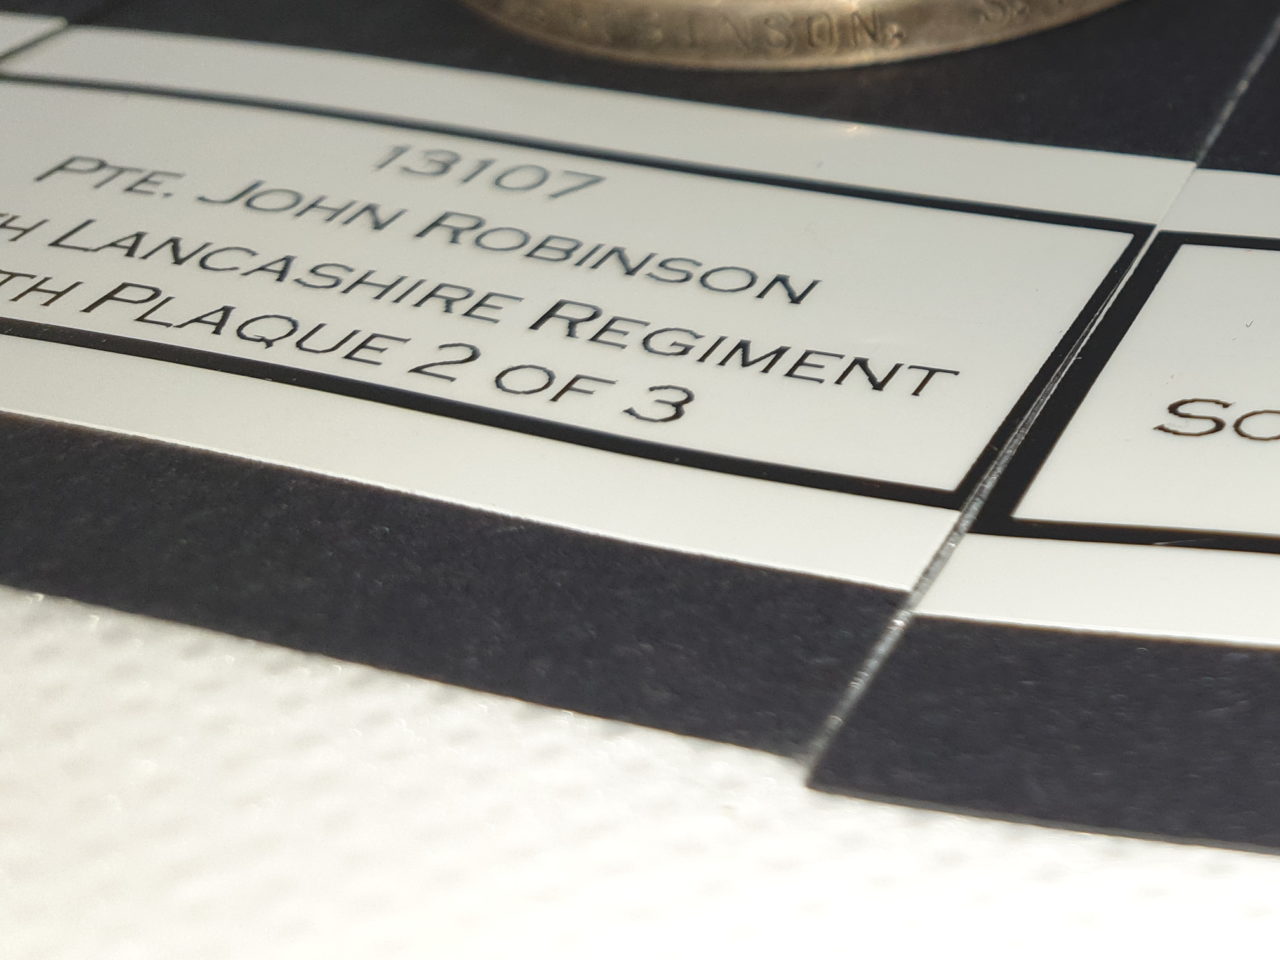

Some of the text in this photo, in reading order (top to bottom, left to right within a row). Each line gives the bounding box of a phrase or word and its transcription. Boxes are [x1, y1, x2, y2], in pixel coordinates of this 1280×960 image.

[374, 145, 606, 200] 13107
[48, 219, 524, 324] LANCASHIRE
[533, 300, 959, 396] REGIMENT
[196, 180, 407, 231] JOHN
[414, 212, 821, 305] ROBINSON
[85, 282, 410, 366] PLAQUE
[408, 343, 481, 382] 2
[494, 365, 613, 402] OF
[623, 385, 694, 423] 3
